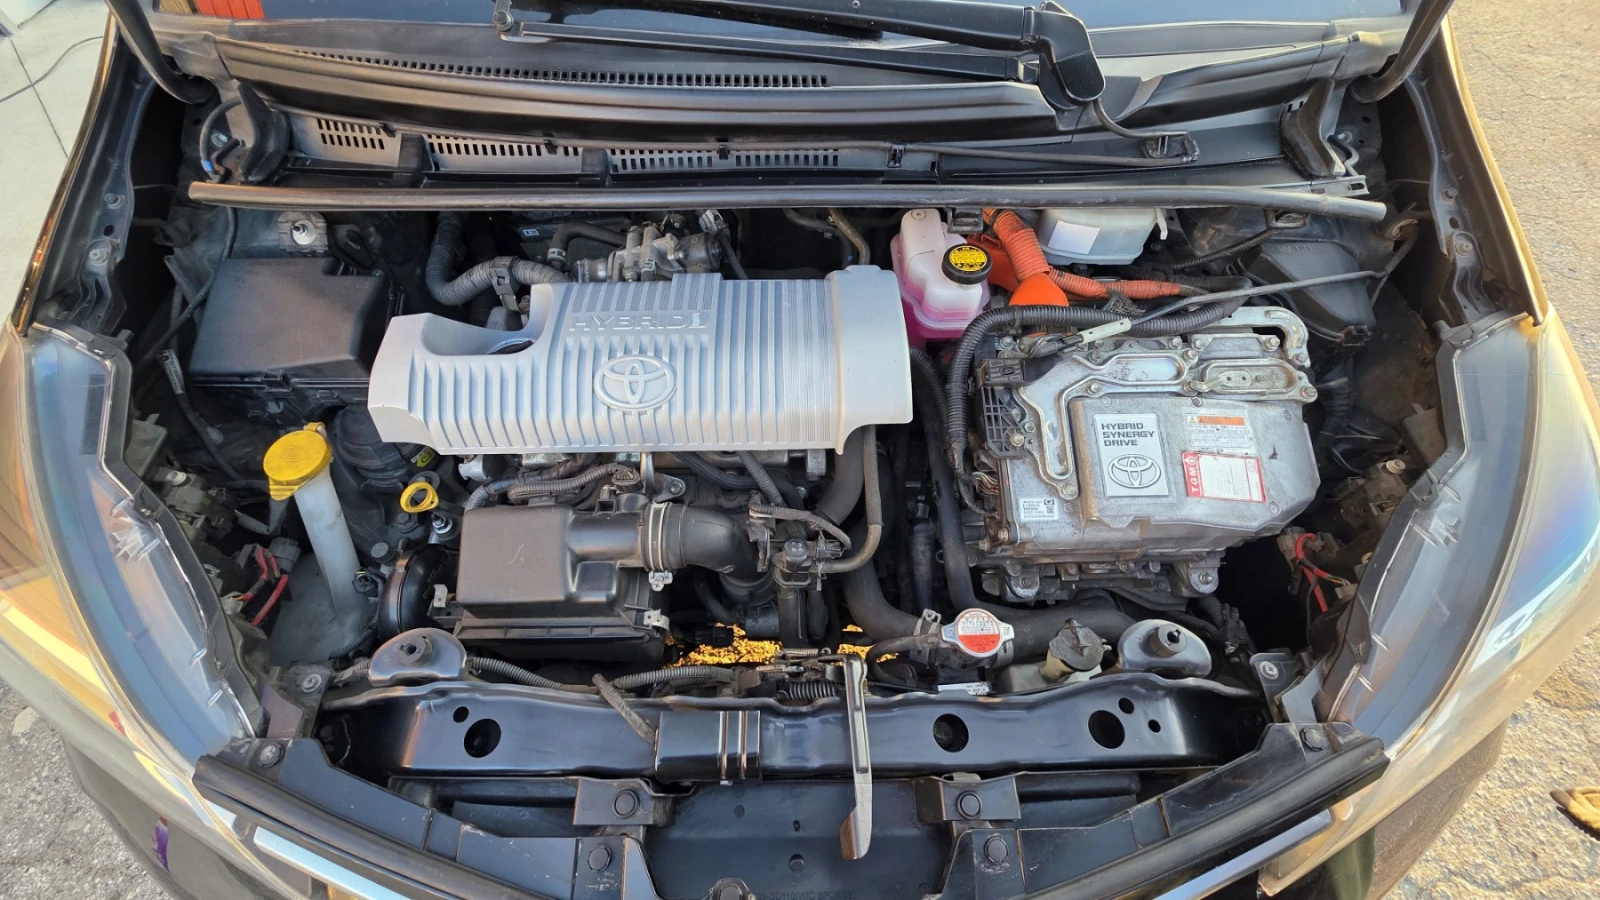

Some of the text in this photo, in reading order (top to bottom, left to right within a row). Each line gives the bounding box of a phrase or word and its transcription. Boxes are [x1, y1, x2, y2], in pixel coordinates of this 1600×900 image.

[568, 314, 687, 332] HYBRID
[1101, 422, 1144, 430] HYBRID
[1102, 430, 1155, 439] SYNERGY
[1103, 439, 1139, 447] DRIVE
